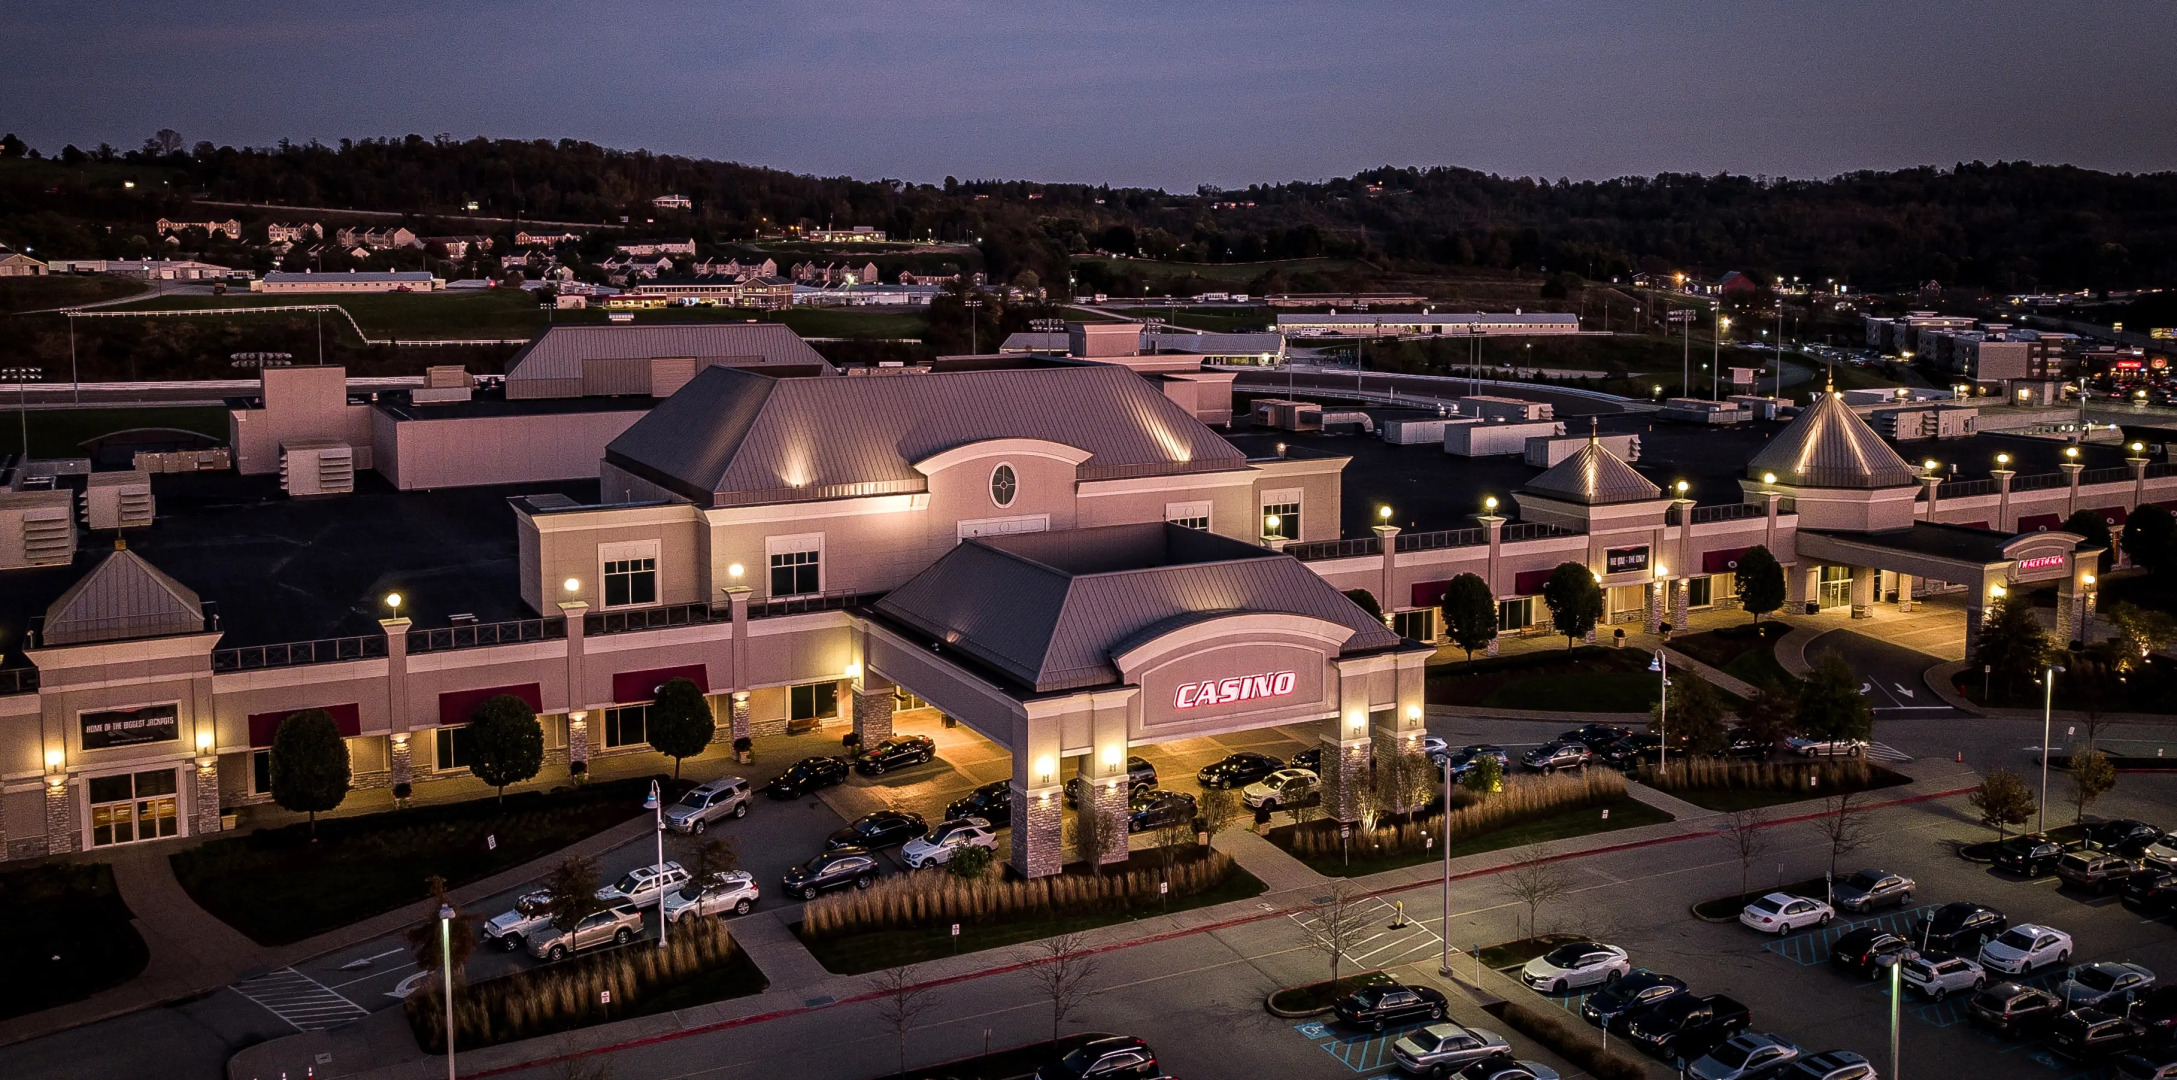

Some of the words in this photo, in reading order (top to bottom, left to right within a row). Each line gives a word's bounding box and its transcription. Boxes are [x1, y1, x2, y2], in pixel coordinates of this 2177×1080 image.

[2019, 555, 2064, 569] RACETRACK
[1173, 670, 1298, 710] CASINO
[86, 724, 103, 733] HOME
[104, 723, 111, 732] OF
[112, 722, 122, 730] THE
[123, 720, 145, 729] BIGGEST
[146, 716, 174, 727] JACKPOTS
